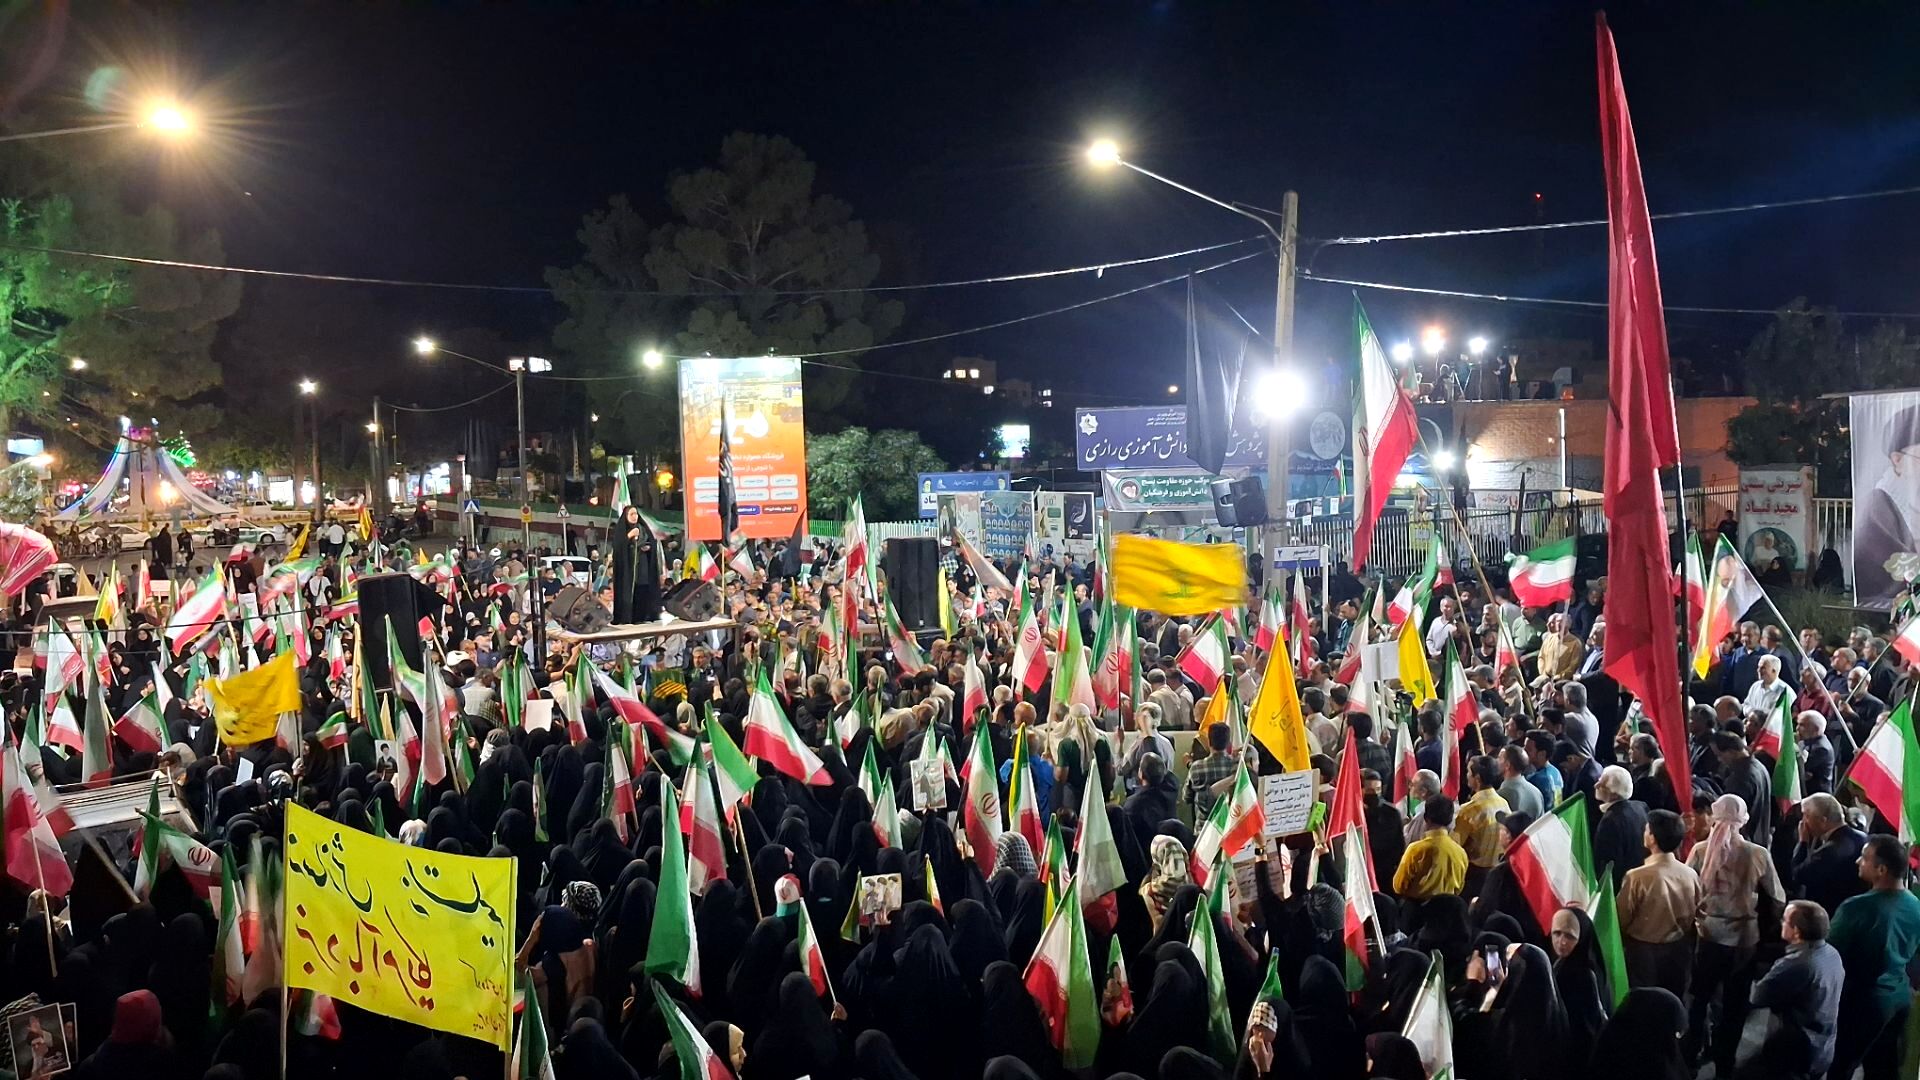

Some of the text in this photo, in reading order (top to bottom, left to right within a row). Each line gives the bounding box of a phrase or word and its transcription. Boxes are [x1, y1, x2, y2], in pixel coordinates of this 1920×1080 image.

[1085, 434, 1118, 463] رازی
[1118, 431, 1164, 462] آموزی
[1158, 430, 1188, 460] دانش
[1141, 476, 1210, 487] موکب حوزه مقاومت بسیج
[1767, 475, 1802, 495] شیرینی
[1143, 488, 1168, 498] فرهنگیان
[1745, 497, 1798, 517] مجید قناد
[1265, 787, 1280, 797] توافق
[1285, 783, 1311, 793] مذاکره
